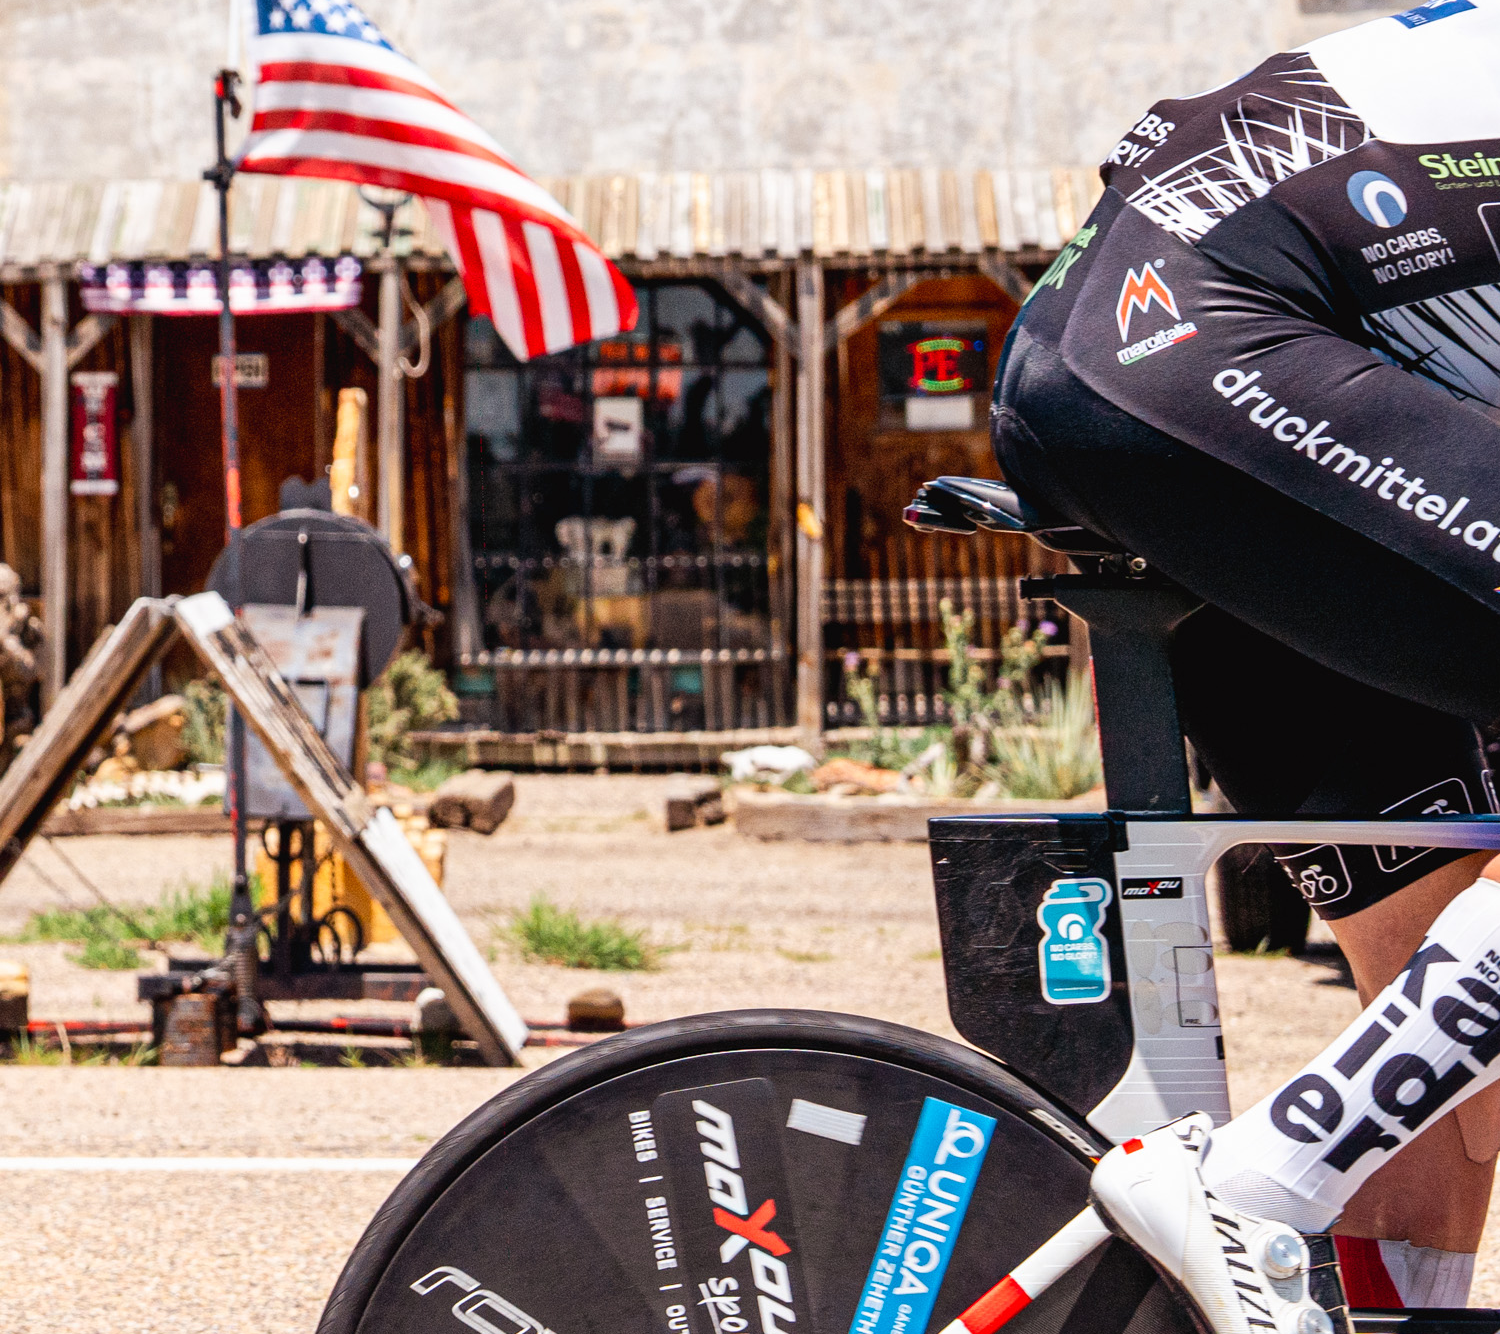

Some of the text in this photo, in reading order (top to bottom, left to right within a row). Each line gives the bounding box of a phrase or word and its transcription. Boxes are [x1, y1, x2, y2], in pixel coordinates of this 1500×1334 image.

[1129, 112, 1176, 147] BS,
[1100, 140, 1156, 168] RY!
[1361, 228, 1448, 263] NO CARBS,
[1372, 248, 1456, 284] NO GLORY!
[1116, 322, 1198, 364] maroitalia
[1475, 961, 1500, 985] NO
[628, 1110, 658, 1162] BIKES
[645, 1196, 678, 1270] SERVICE
[883, 1165, 928, 1258] GÜNTHER
[892, 1169, 967, 1296] UNIQA
